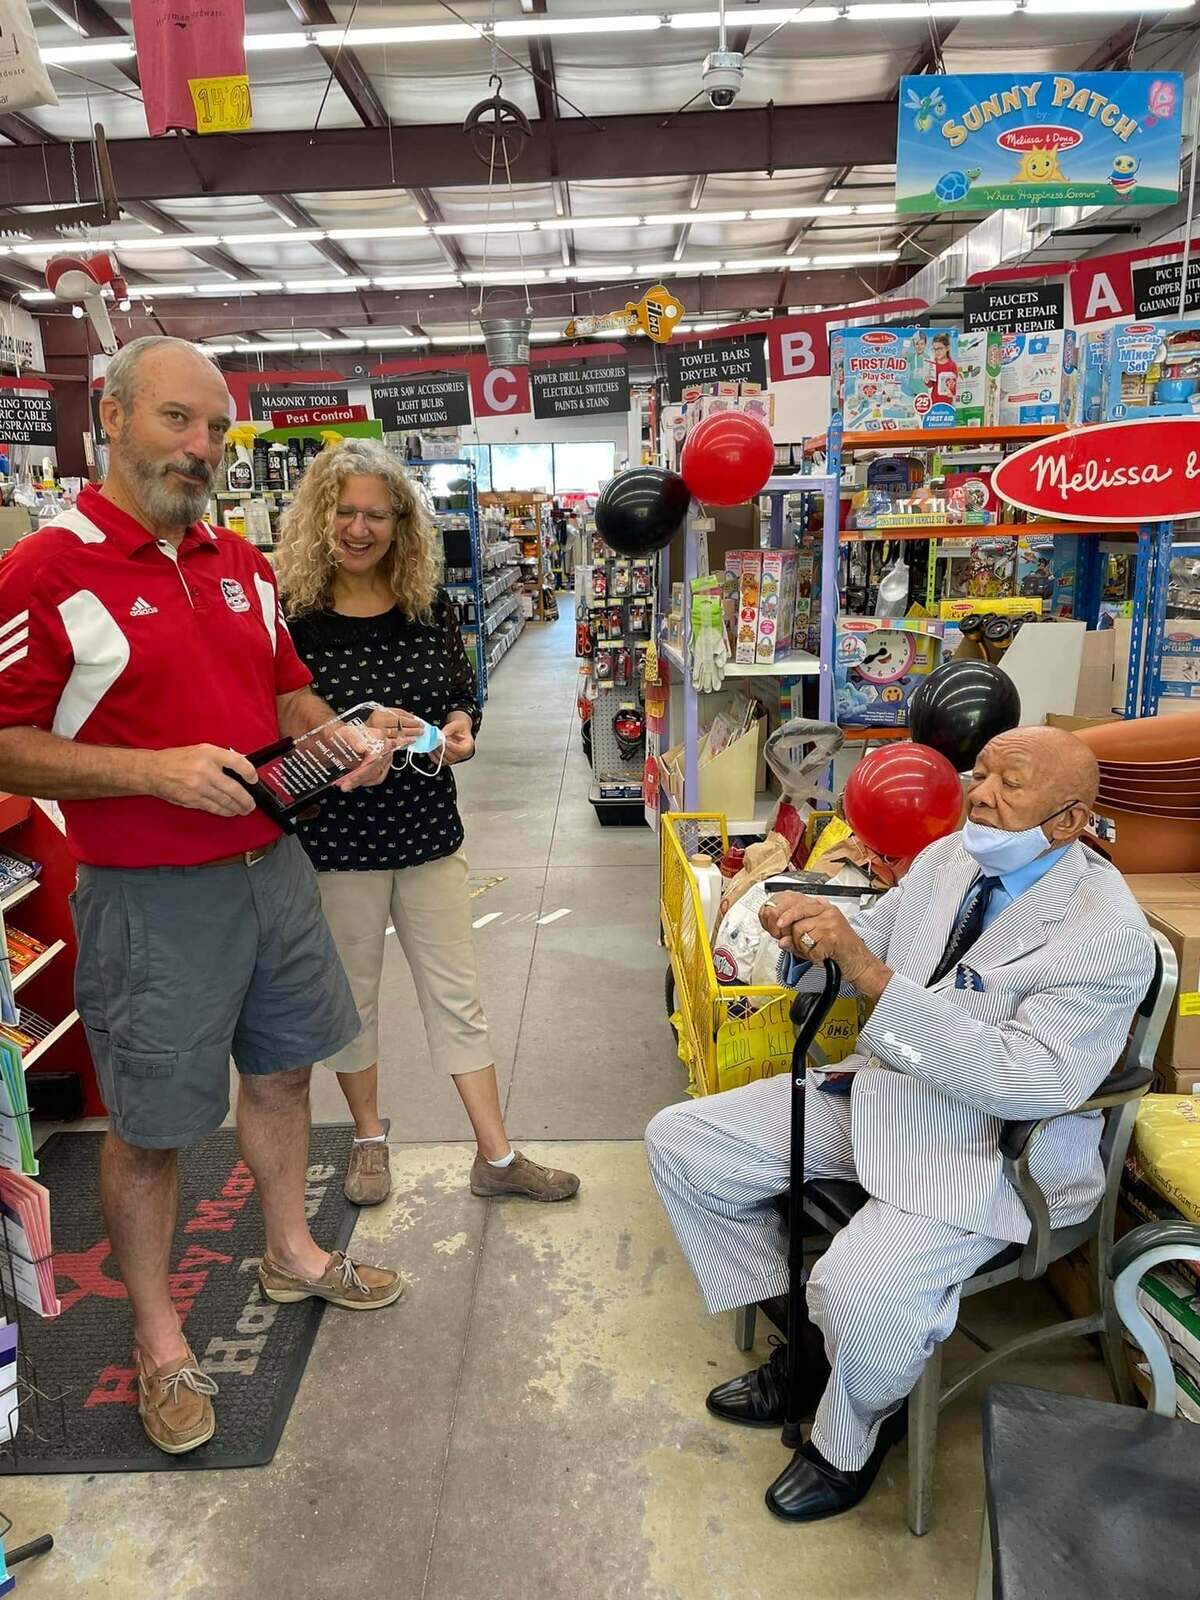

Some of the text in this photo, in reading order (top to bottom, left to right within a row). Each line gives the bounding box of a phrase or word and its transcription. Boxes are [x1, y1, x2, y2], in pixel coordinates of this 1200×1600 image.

[941, 76, 1140, 148] SUNNY PATCH
[1006, 132, 1043, 147] Melissa
[1052, 132, 1075, 147] Doug
[1156, 268, 1172, 281] PVC
[1085, 272, 1122, 318] A
[1149, 281, 1181, 297] COPPER
[989, 292, 1039, 307] FAUCETS
[1140, 294, 1193, 313] GALVANIZD
[969, 304, 1058, 324] FAUCET REPAIR
[1015, 319, 1055, 333] REPAIR
[680, 348, 750, 367] TOWEL BARS
[780, 332, 816, 376] B
[1121, 349, 1155, 361] Mixer
[680, 362, 752, 381] DRYER VENT
[850, 357, 907, 371] FIRST AID
[1128, 361, 1146, 372] Set
[533, 367, 626, 385] POWER DRILL ACCESSORIES
[863, 372, 895, 381] Play Set
[374, 382, 465, 399] POWER SAW ACCESSORIES
[483, 368, 518, 412] C
[543, 382, 619, 398] ELECTRICAL SWITCHES
[22, 399, 52, 410] TOOLS
[262, 395, 338, 407] MASONRY TOOLS
[397, 397, 444, 411] LIGHT BULBS
[555, 397, 609, 411] PAINTS & STAINS
[916, 397, 929, 407] 25
[17, 410, 48, 421] CABLE
[286, 413, 309, 424] Pest
[313, 408, 353, 422] Control
[397, 411, 448, 425] PAINT MIXING
[1030, 453, 1172, 500] Melissa
[129, 606, 159, 617] adidas
[827, 1027, 849, 1036] OMG
